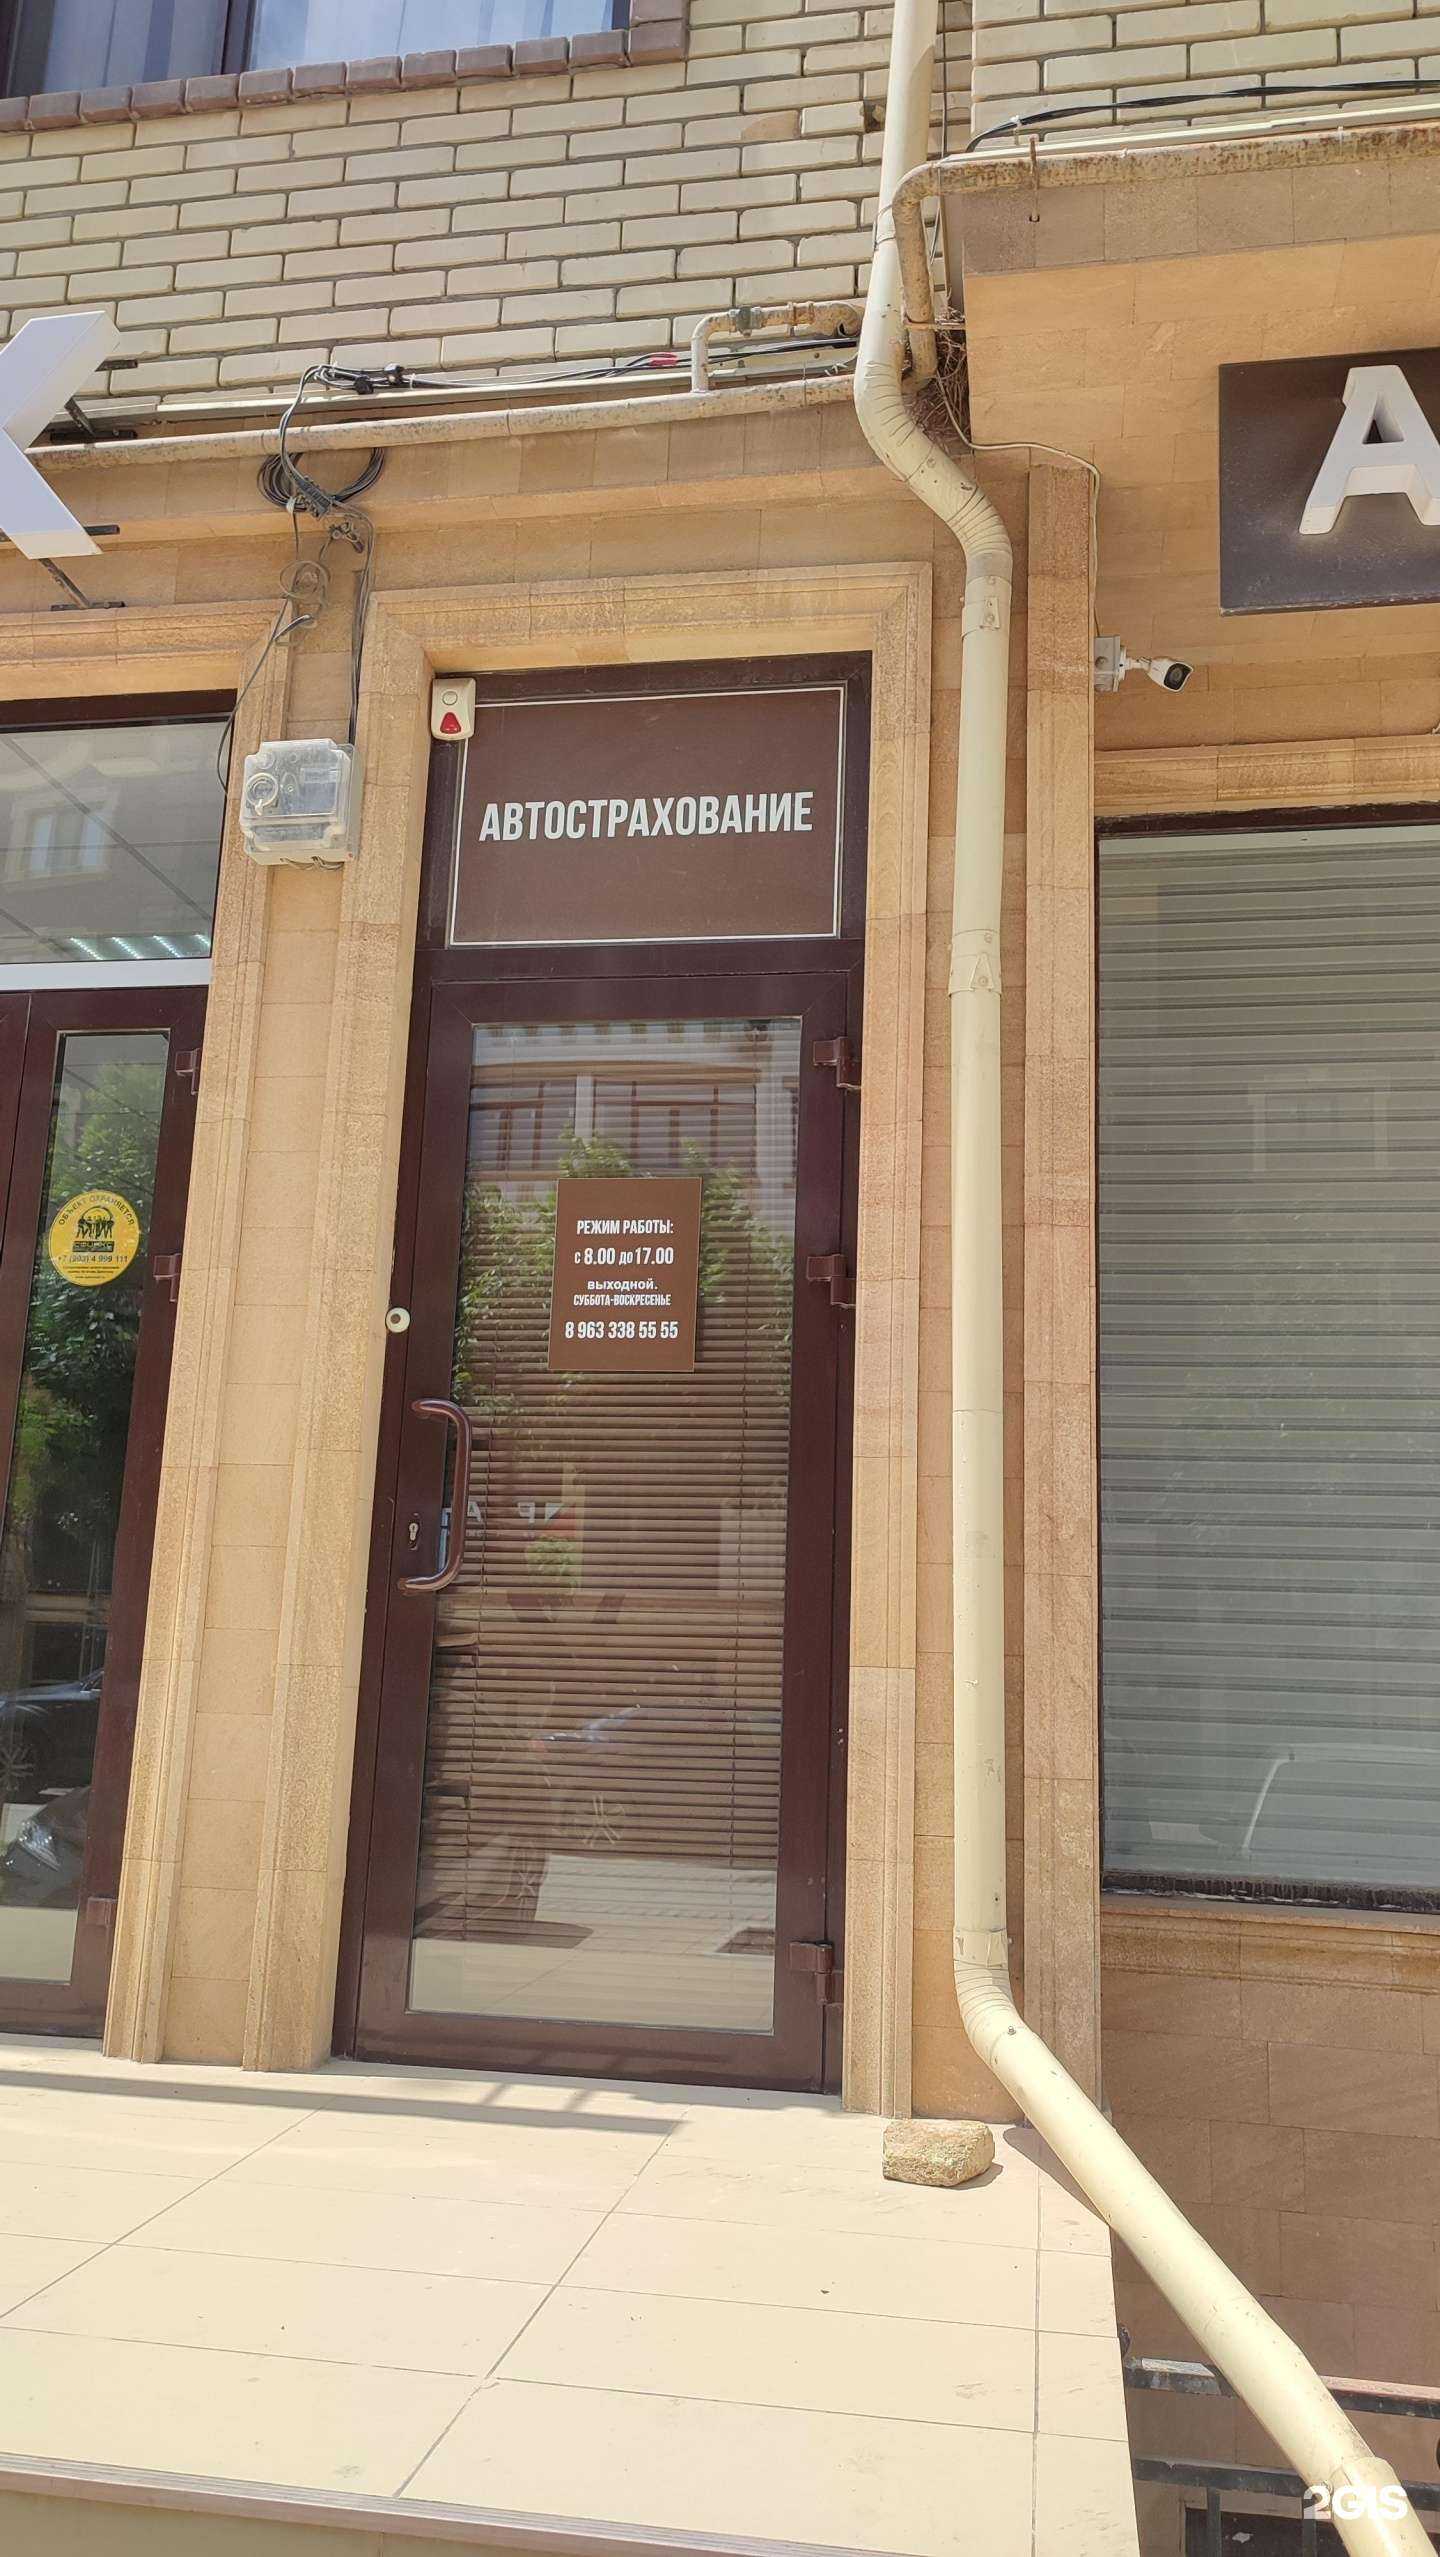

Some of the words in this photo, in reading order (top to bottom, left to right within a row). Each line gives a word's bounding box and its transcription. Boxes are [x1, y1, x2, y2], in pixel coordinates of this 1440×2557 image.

[478, 791, 814, 842] АВТОСТРАХОВАНИЕ
[58, 1199, 87, 1226] ОБЪЕКТ
[576, 1220, 620, 1235] РЕЖИМ
[622, 1219, 674, 1234] РАБОТЫ:
[574, 1251, 581, 1264] с
[584, 1247, 615, 1265] 8.00
[619, 1251, 633, 1265] до
[635, 1247, 674, 1265] 17.00
[573, 1294, 672, 1306] СУББОТА-ВОСКРЕСЕНЬЕ
[565, 1321, 574, 1339] 8
[577, 1321, 605, 1339] 963
[608, 1321, 635, 1339] 338
[638, 1321, 657, 1339] 55
[660, 1321, 679, 1339] 55
